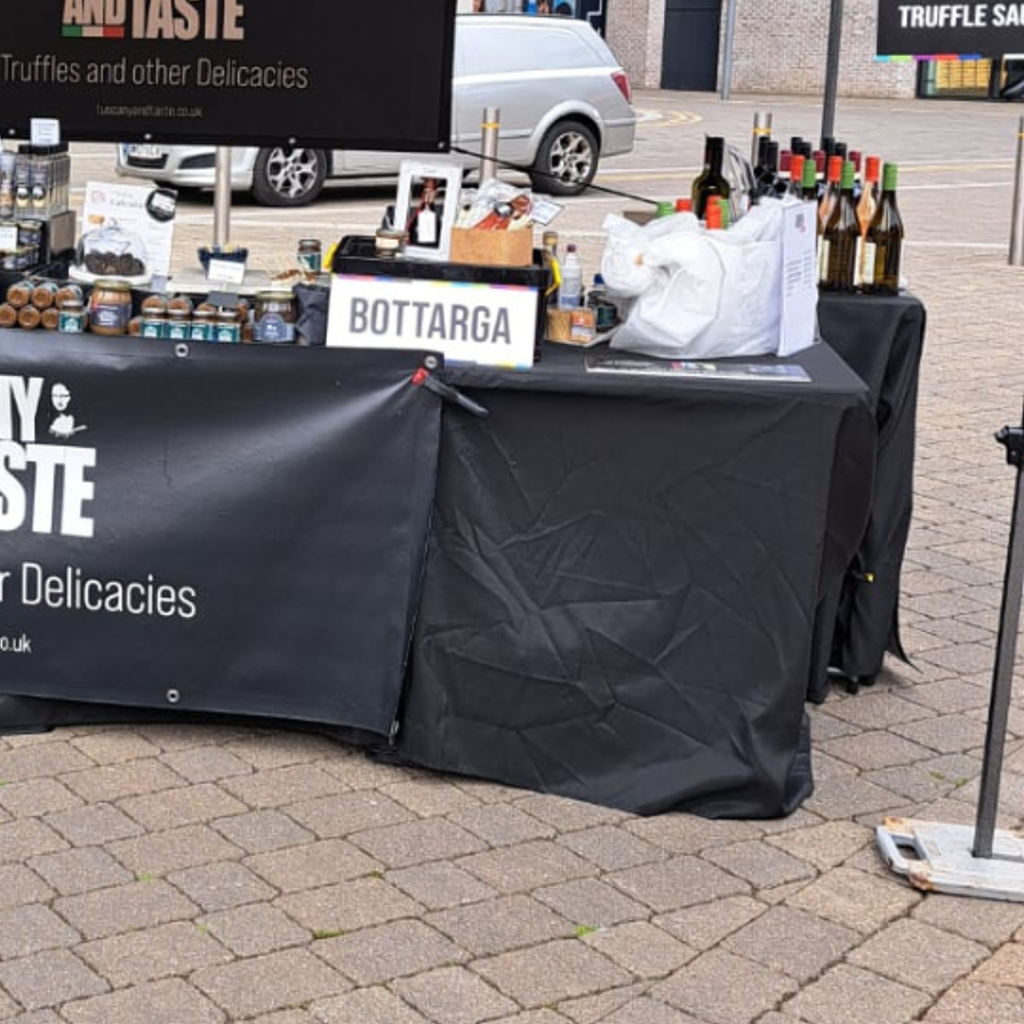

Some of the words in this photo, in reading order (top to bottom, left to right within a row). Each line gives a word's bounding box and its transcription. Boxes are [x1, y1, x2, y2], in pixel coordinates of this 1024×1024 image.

[898, 4, 988, 28] TRUFFLE
[0, 53, 81, 84] Truffles
[86, 57, 126, 85] and
[132, 57, 191, 86] other
[196, 57, 309, 89] Delicacies
[348, 297, 512, 345] BOTTARGA
[22, 561, 197, 619] Delicacies
